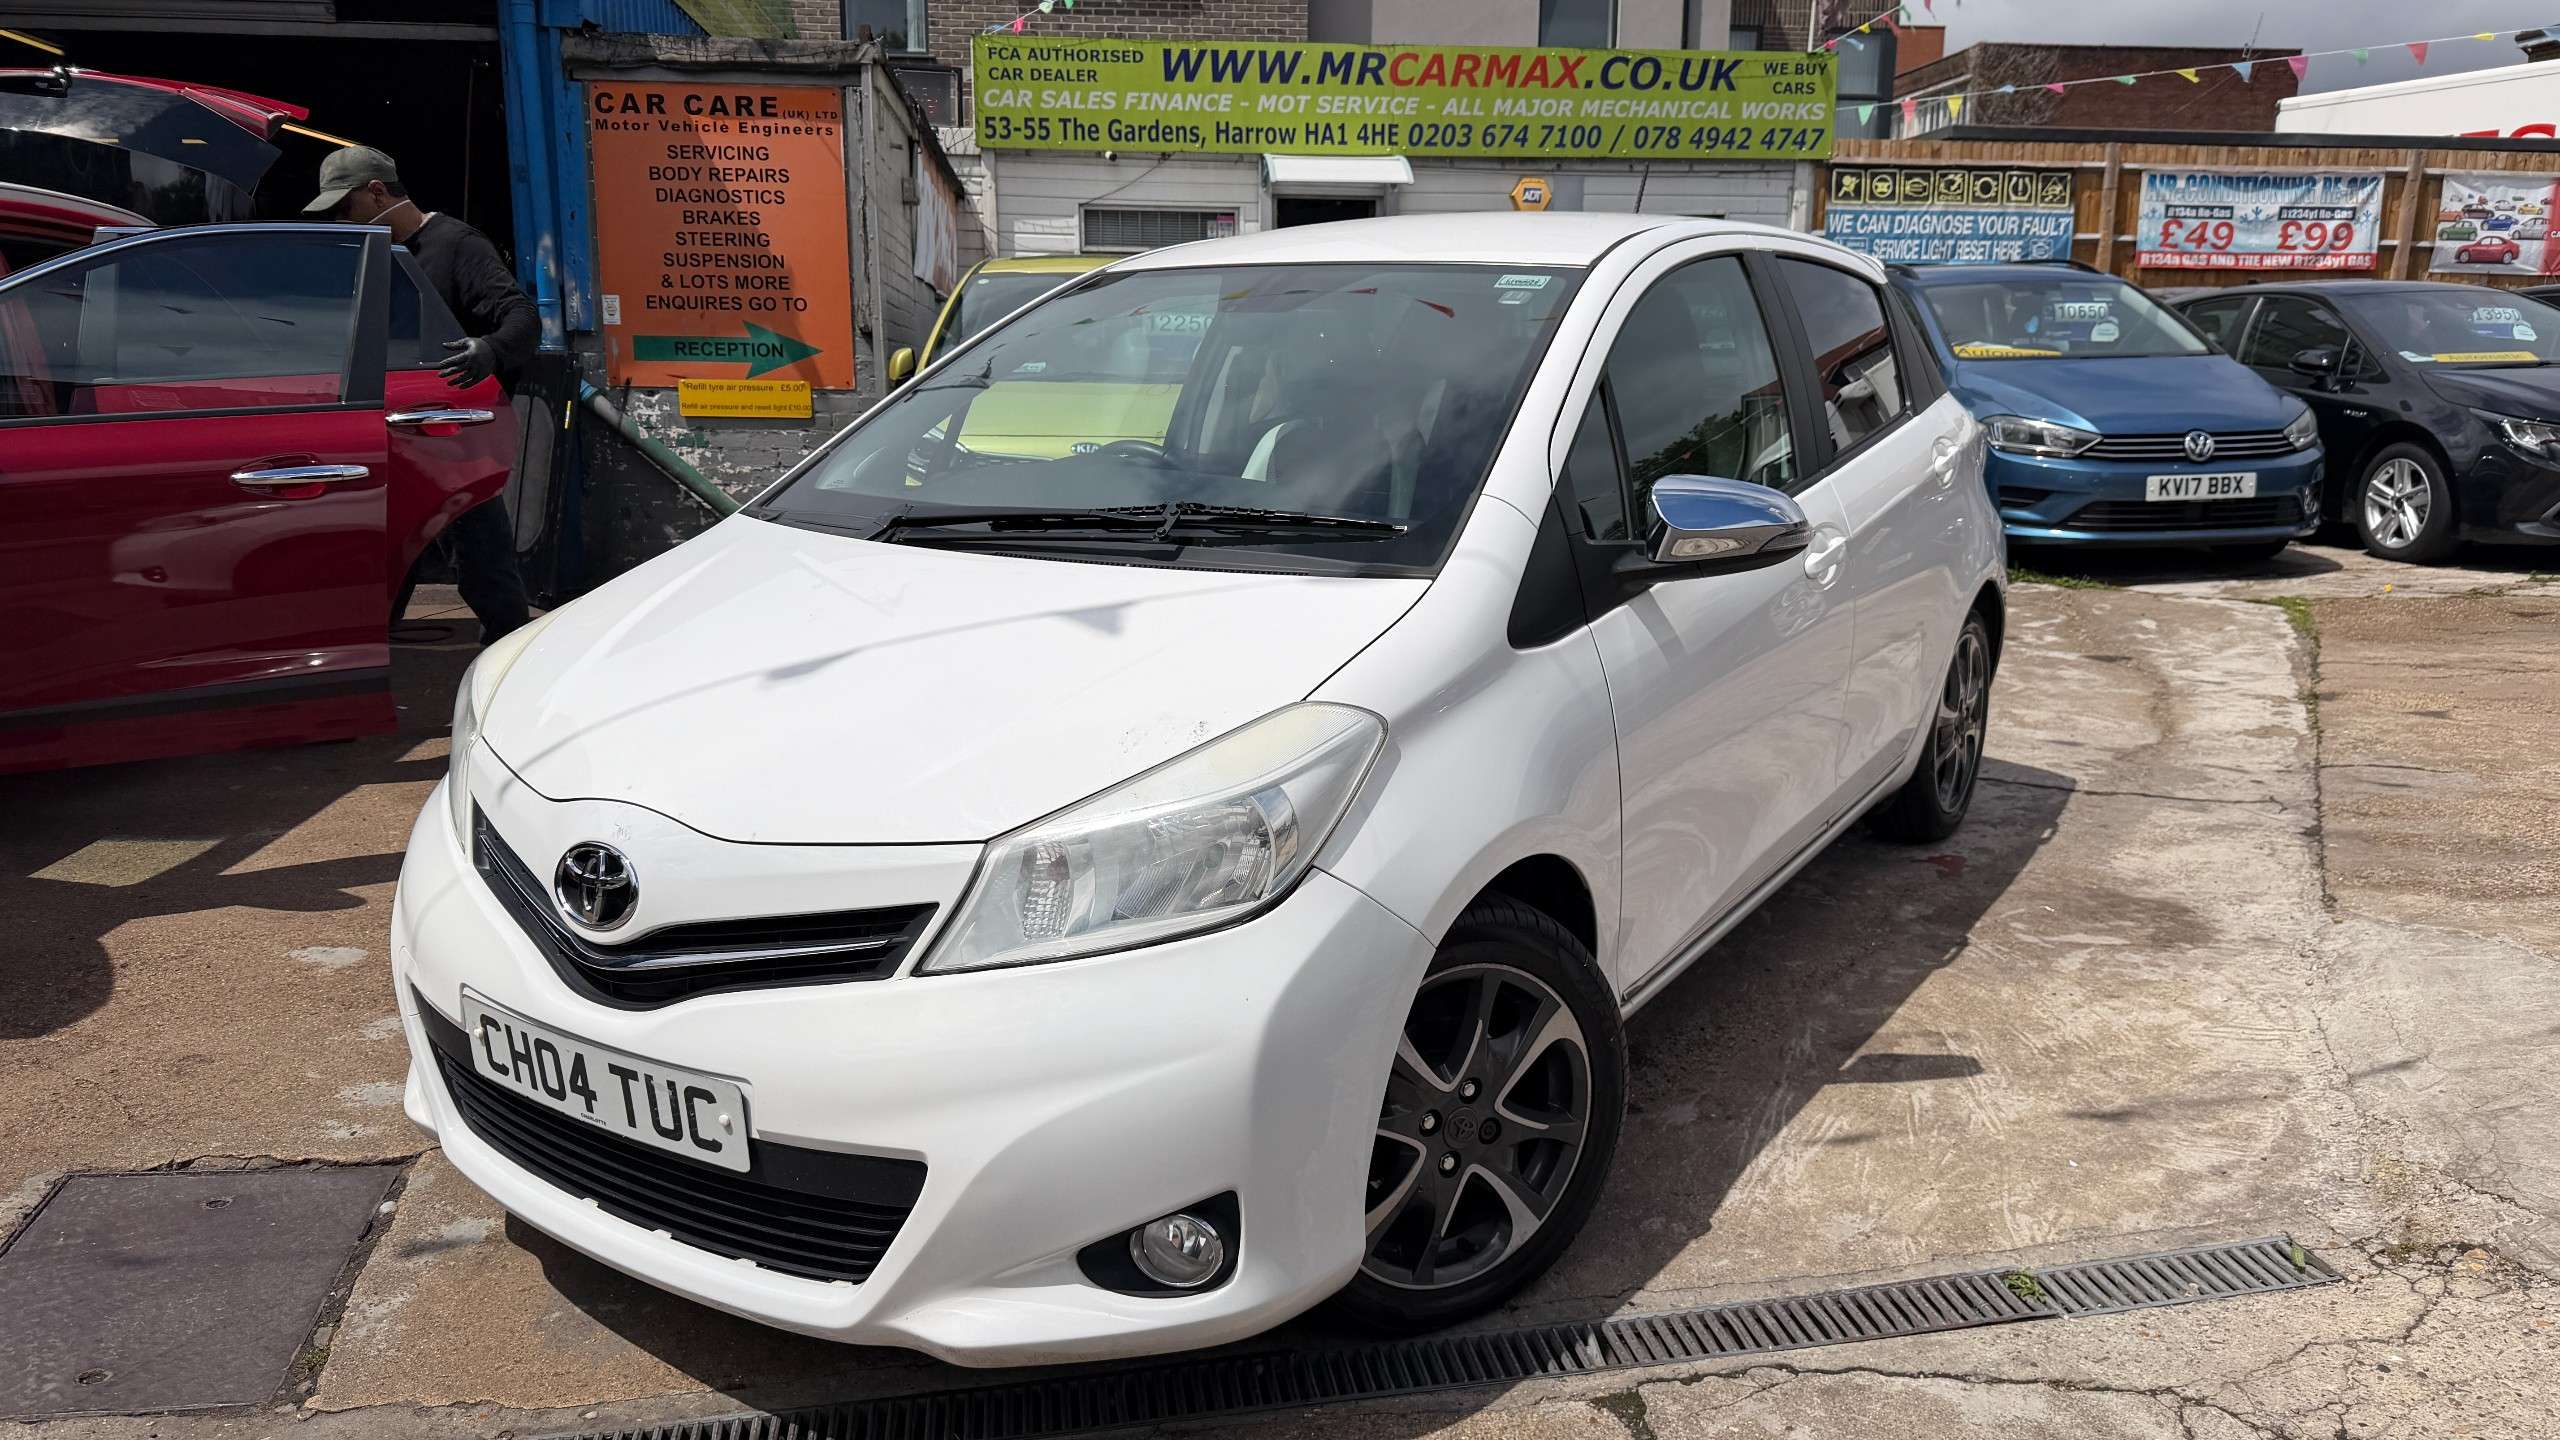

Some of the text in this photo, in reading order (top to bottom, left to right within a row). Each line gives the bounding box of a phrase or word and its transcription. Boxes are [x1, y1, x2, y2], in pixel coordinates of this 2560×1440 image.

[988, 47, 1144, 63] FCA AUTHORISED
[988, 67, 1098, 82] CAR DEALER
[1162, 48, 1742, 91] WWW.MRCARMAX.CO.UK
[1764, 62, 1828, 76] WE BUY
[1772, 82, 1815, 95] CARS
[595, 92, 838, 120] CAR CARE (UK) LTD
[983, 88, 1032, 108] CAR
[1039, 90, 1116, 110] SALES
[1123, 91, 1232, 112] FINANCE
[1257, 94, 1310, 113] MOT
[1317, 94, 1417, 115] SERVICE
[1442, 98, 1484, 117] ALL
[1493, 99, 1573, 118] MAJOR
[1581, 100, 1731, 120] MECHANICAL
[1740, 102, 1825, 121] WORKS
[595, 118, 834, 137] Motor Vehicle Engineers
[984, 116, 1824, 152] 53-55 The Gardens, Harrow HA1 4HE 0203 674 7100 / 078 4942 4747
[667, 145, 769, 161] SERVICING
[649, 167, 790, 183] BODY REPAIRS
[655, 188, 785, 205] DIAGNOSTICS
[1523, 190, 1542, 201] ADT
[683, 210, 761, 226] BRAKES
[1829, 214, 1854, 233] WE
[1856, 214, 1890, 234] CAN
[1893, 215, 1974, 235] DIAGNOSE
[1978, 215, 2020, 235] YOUR
[676, 232, 770, 247] STEERING
[2159, 219, 2234, 250] £49
[2276, 220, 2353, 251] £99
[1872, 239, 1919, 259] SERVICE
[1920, 240, 1955, 260] LIGHT
[1955, 240, 1991, 260] RESET
[1992, 240, 2023, 261] HERE
[663, 253, 784, 269] SUSPENSION
[2182, 255, 2206, 265] GAS
[2209, 255, 2236, 266] AND
[2238, 256, 2261, 266] THE
[2263, 256, 2292, 266] NEW
[2348, 256, 2371, 266] GAS
[661, 274, 790, 290] & LOTS MORE
[646, 296, 807, 312] ENQUIRES GO TO
[675, 341, 784, 358] RECEPTION
[687, 382, 706, 390] Refill
[709, 383, 724, 392] tyre
[726, 383, 736, 391] air
[739, 384, 773, 392] pressure
[2159, 474, 2244, 496] KV17 BBX
[480, 1013, 723, 1153] CH04 TUC
